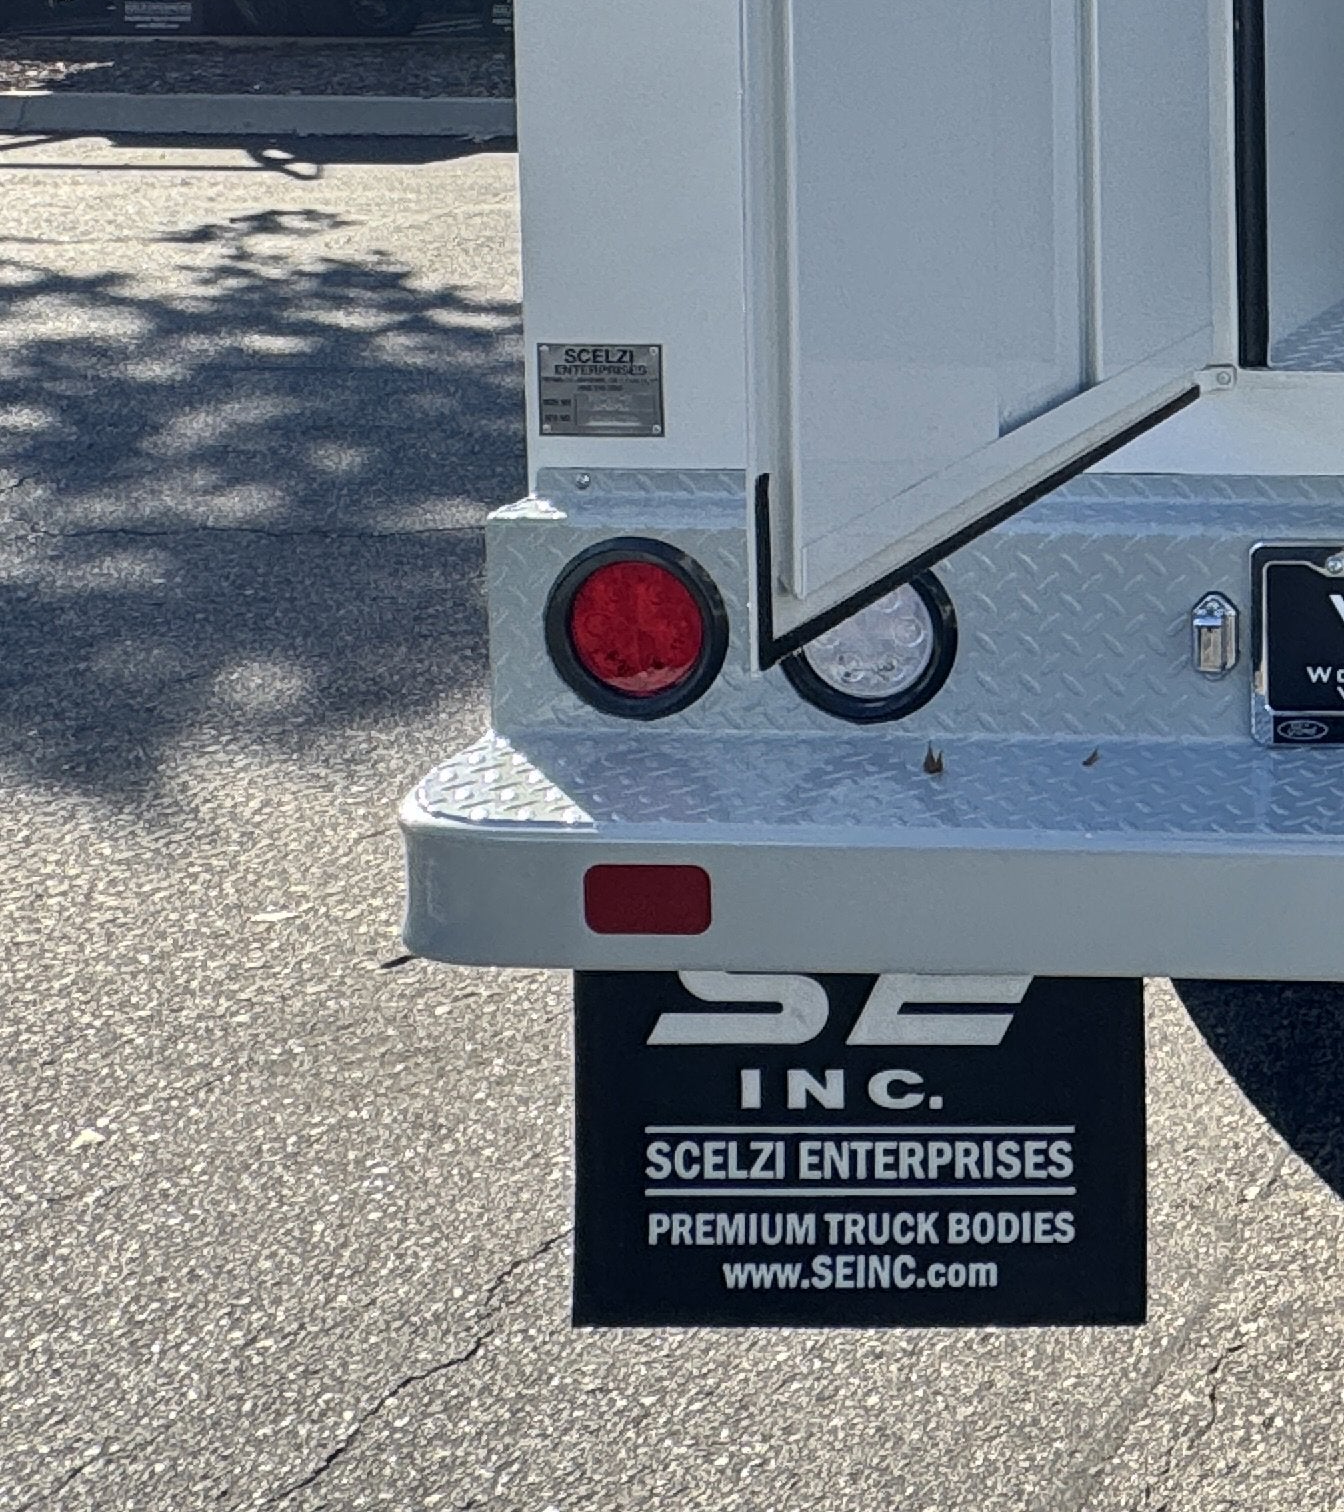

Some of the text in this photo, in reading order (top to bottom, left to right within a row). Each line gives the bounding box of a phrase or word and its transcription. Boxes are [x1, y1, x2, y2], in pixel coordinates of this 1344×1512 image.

[564, 348, 634, 364] SCELZI
[646, 970, 1035, 1046] SE
[740, 1068, 944, 1110] INC.
[645, 1140, 1075, 1180] SCELZI ENTERPRISES
[648, 1211, 1076, 1246] PREMIUM TRUCK BODIES
[722, 1254, 998, 1289] www.SEINC.com
